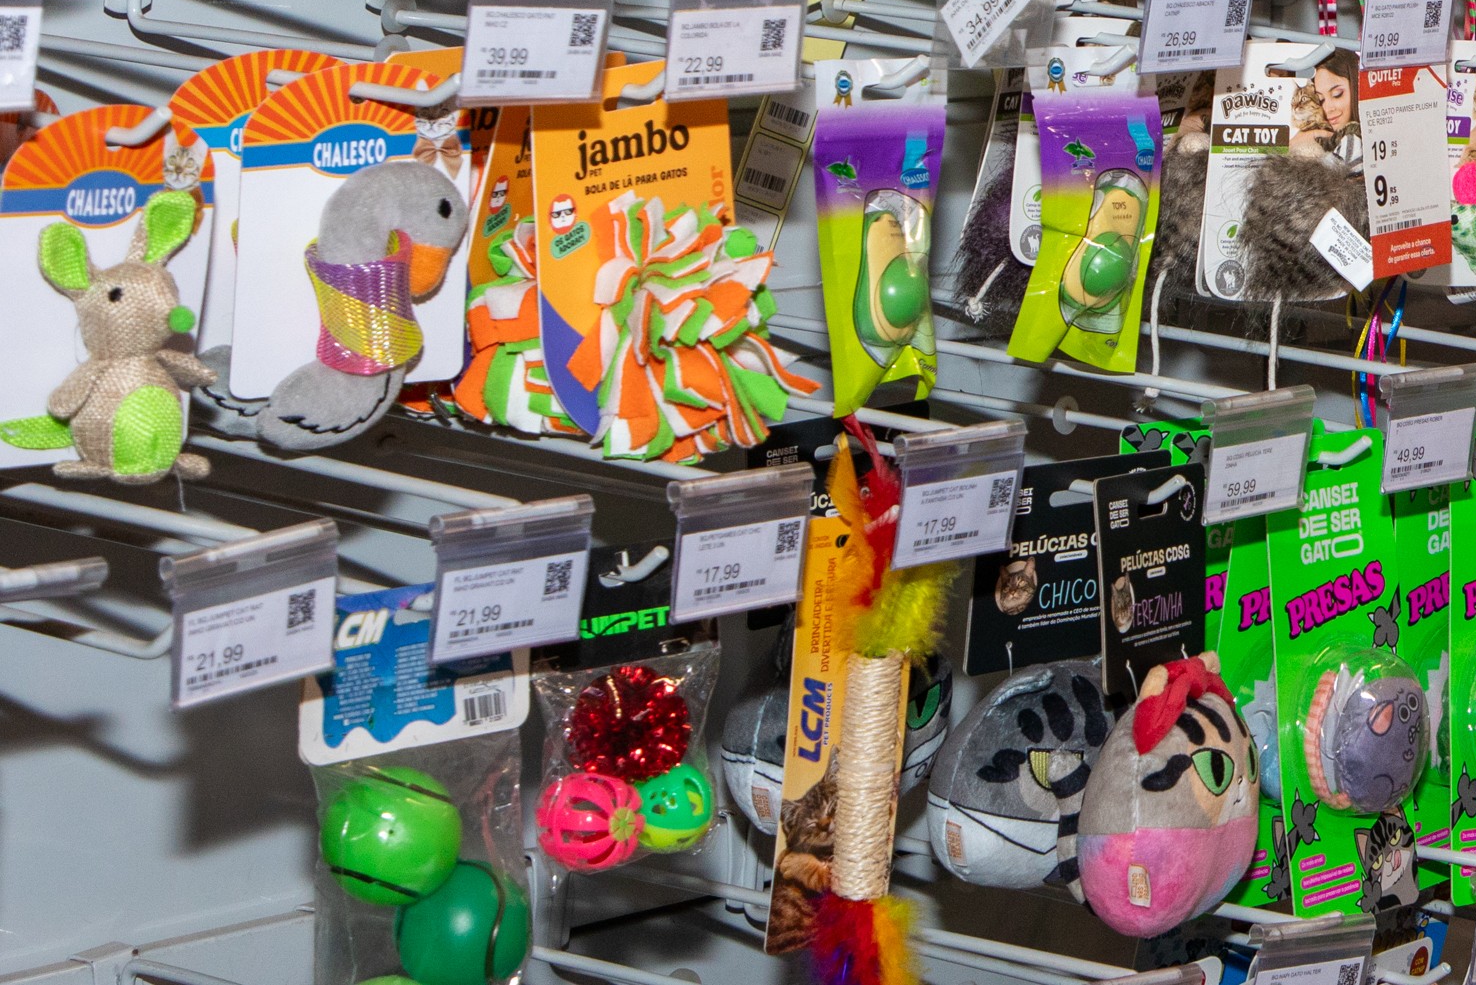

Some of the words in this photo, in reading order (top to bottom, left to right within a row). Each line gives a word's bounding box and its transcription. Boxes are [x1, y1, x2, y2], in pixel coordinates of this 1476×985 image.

[1165, 31, 1197, 48] 26,99
[1373, 32, 1399, 48] 19,99
[486, 48, 529, 66] 39,99
[684, 56, 724, 74] 22,99
[1368, 68, 1403, 84] OUTLET
[1221, 92, 1279, 120] pawise
[1395, 103, 1414, 114] PAWISE
[1414, 101, 1433, 111] PLUSH
[1222, 127, 1250, 144] CAT
[1254, 127, 1279, 144] TOY
[313, 138, 387, 168] CHALESCO
[575, 120, 690, 180] jambo
[1372, 140, 1387, 162] 19
[585, 182, 608, 196] BOLA
[609, 179, 621, 192] DE
[622, 174, 634, 189] LÃ
[634, 172, 659, 186] PARA
[660, 167, 689, 182] GATOS
[588, 167, 603, 177] PET
[67, 186, 136, 216] CHALESCO
[1374, 174, 1388, 208] 9
[1390, 240, 1411, 253] Aproveite
[1415, 237, 1432, 247] chance
[766, 446, 798, 458] CANSEI
[1396, 446, 1426, 464] 49,99
[1226, 478, 1258, 498] 59,99
[1302, 482, 1359, 513] CANSEI
[1109, 499, 1129, 510] CANSEI
[1119, 508, 1130, 519] SER
[922, 516, 956, 535] 17,99
[1299, 514, 1328, 539] DE
[1330, 508, 1362, 532] SER
[1008, 532, 1088, 558] PELÚCIAS
[1120, 548, 1165, 573] PELÚCIAS
[1165, 543, 1191, 564] CDSG
[1300, 534, 1364, 566] GATO
[703, 563, 741, 583] 17,99
[1038, 578, 1097, 610] CHICO
[1285, 559, 1386, 640] PRESAS
[456, 604, 502, 628] 21,99
[811, 578, 823, 654] BRINCADEIRA
[1130, 591, 1184, 629] TEREZINHA
[820, 610, 833, 673] DIVERTIDA
[197, 644, 244, 671] 21,99
[823, 682, 833, 729] PRODUCTS
[798, 676, 827, 763] LCM
